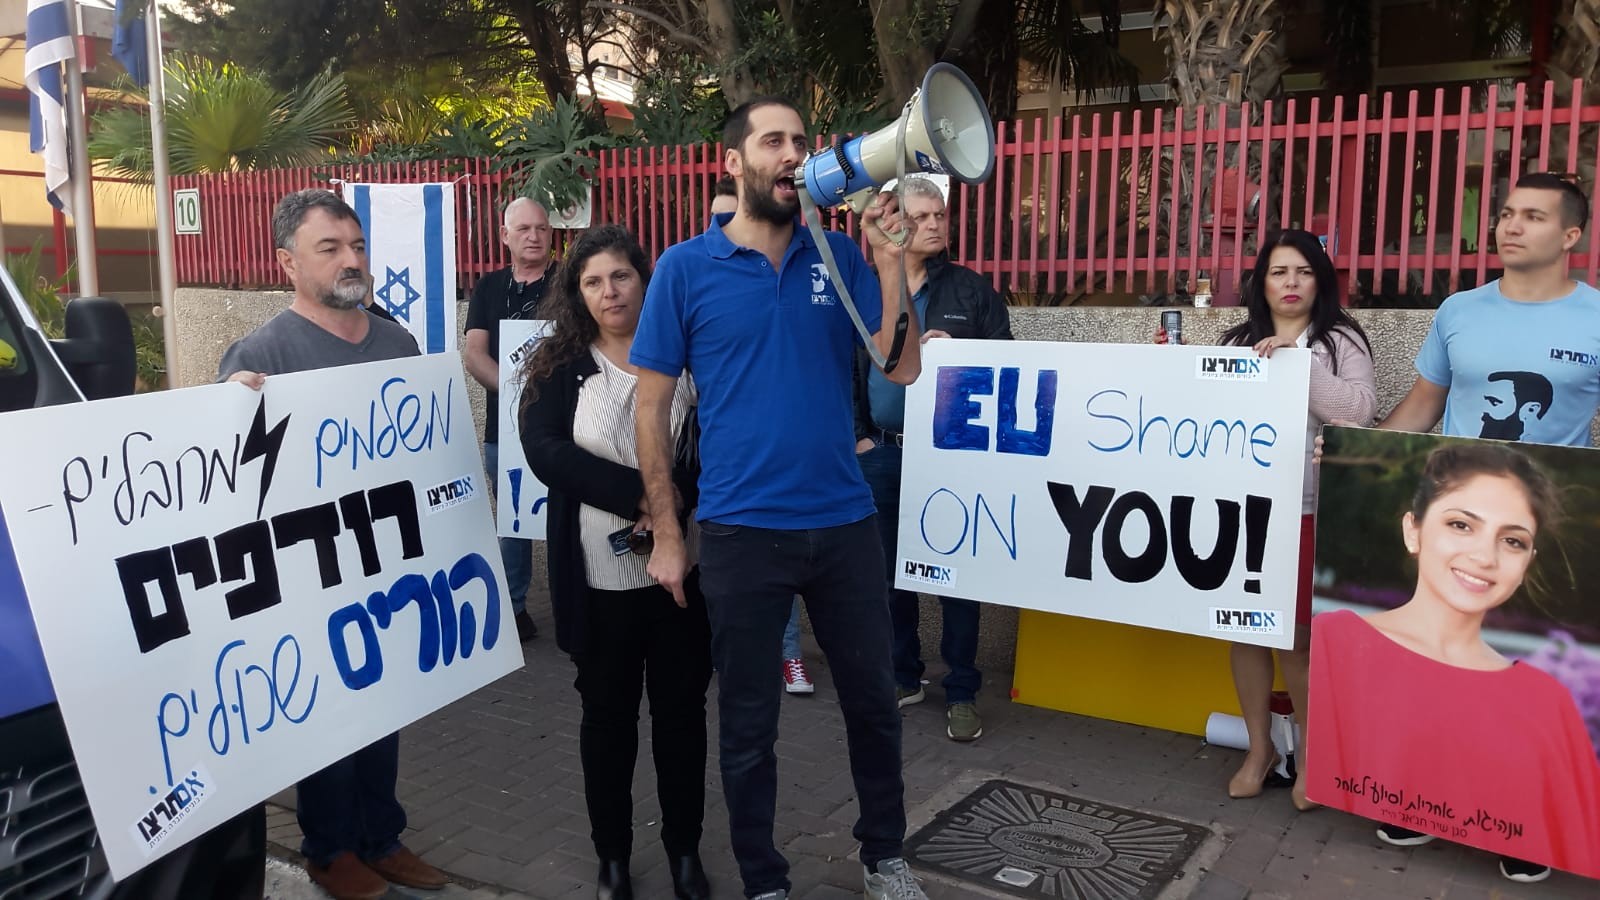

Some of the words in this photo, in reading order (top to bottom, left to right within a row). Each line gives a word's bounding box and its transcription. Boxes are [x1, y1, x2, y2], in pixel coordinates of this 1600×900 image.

[178, 197, 197, 227] 10
[315, 377, 453, 489] משלמים
[932, 365, 1058, 457] EU
[1086, 389, 1278, 468] Shame
[114, 480, 425, 654] רודפים
[920, 487, 1017, 561] ON
[1046, 480, 1273, 594] YOU!
[328, 552, 501, 691] הורים
[1334, 775, 1371, 796] לאחר
[1370, 781, 1403, 805] וסיוע
[1405, 794, 1456, 819] אחריות
[1463, 809, 1523, 841] מנהיגות
